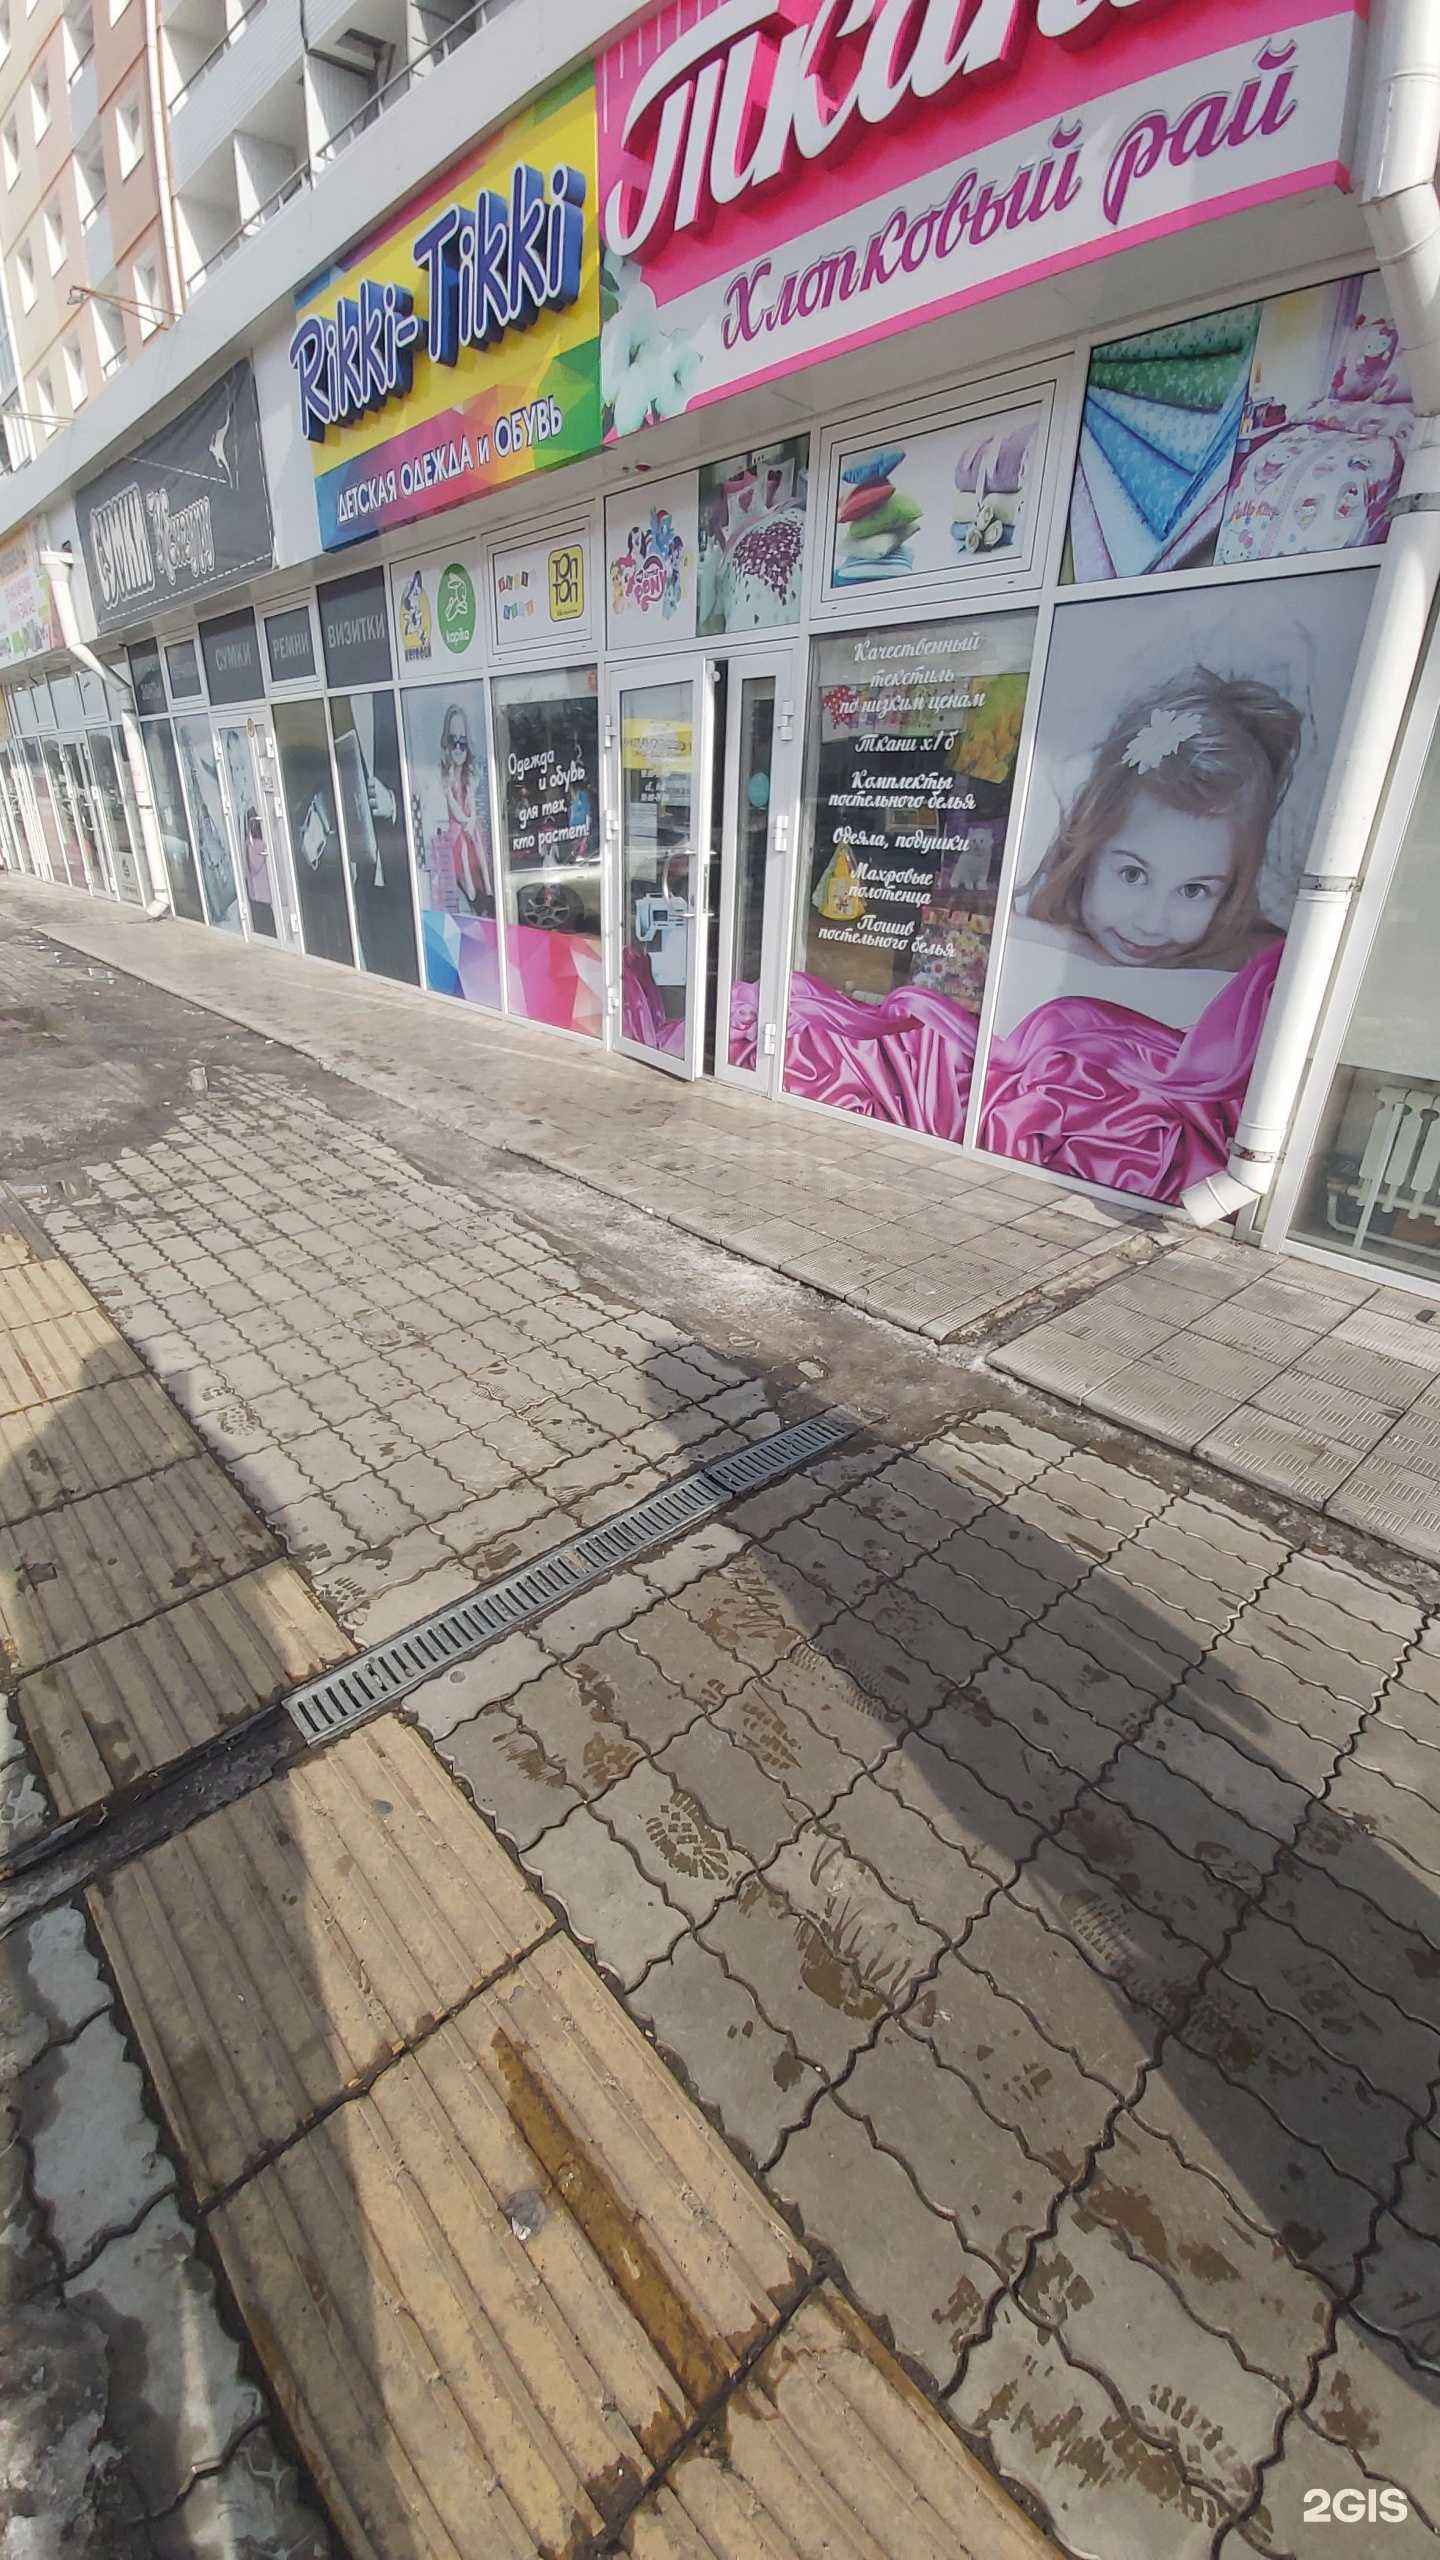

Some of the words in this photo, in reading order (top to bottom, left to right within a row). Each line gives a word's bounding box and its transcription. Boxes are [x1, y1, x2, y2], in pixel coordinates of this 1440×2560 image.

[603, 0, 1141, 256] Тка
[722, 118, 1082, 351] Хлопковый
[1103, 38, 1298, 226] рай
[288, 162, 580, 441] Rikki-Tikki
[337, 467, 397, 525] ДЕТСКАЯ
[400, 434, 473, 498] ОДЕЖДА
[494, 394, 564, 457] ОБУВЬ
[90, 482, 155, 609] СУМКИ
[272, 631, 311, 661] РЕМНИ
[326, 612, 386, 650] ВИЗИТКИ
[215, 640, 252, 672] СУМКИ
[854, 631, 985, 662] Качественный
[870, 665, 954, 688] текстиль
[839, 696, 857, 714] по
[862, 695, 925, 719] низким
[928, 692, 986, 715] ценам
[855, 732, 916, 753] Ткани
[507, 750, 556, 780] Одежда
[538, 777, 547, 791] и
[550, 761, 586, 792] обувь
[851, 769, 954, 791] Комплекты
[828, 790, 925, 809] постельного
[928, 790, 977, 810] белья
[512, 834, 535, 851] кто
[538, 815, 591, 847] растет!
[518, 808, 538, 830] для
[832, 826, 889, 849] Одеяла,
[894, 829, 971, 854] подушки
[850, 861, 934, 887] Махровые
[848, 884, 933, 908] полотенца
[857, 914, 916, 937] Пошив
[818, 926, 908, 950] постельного
[911, 935, 957, 958] белья
